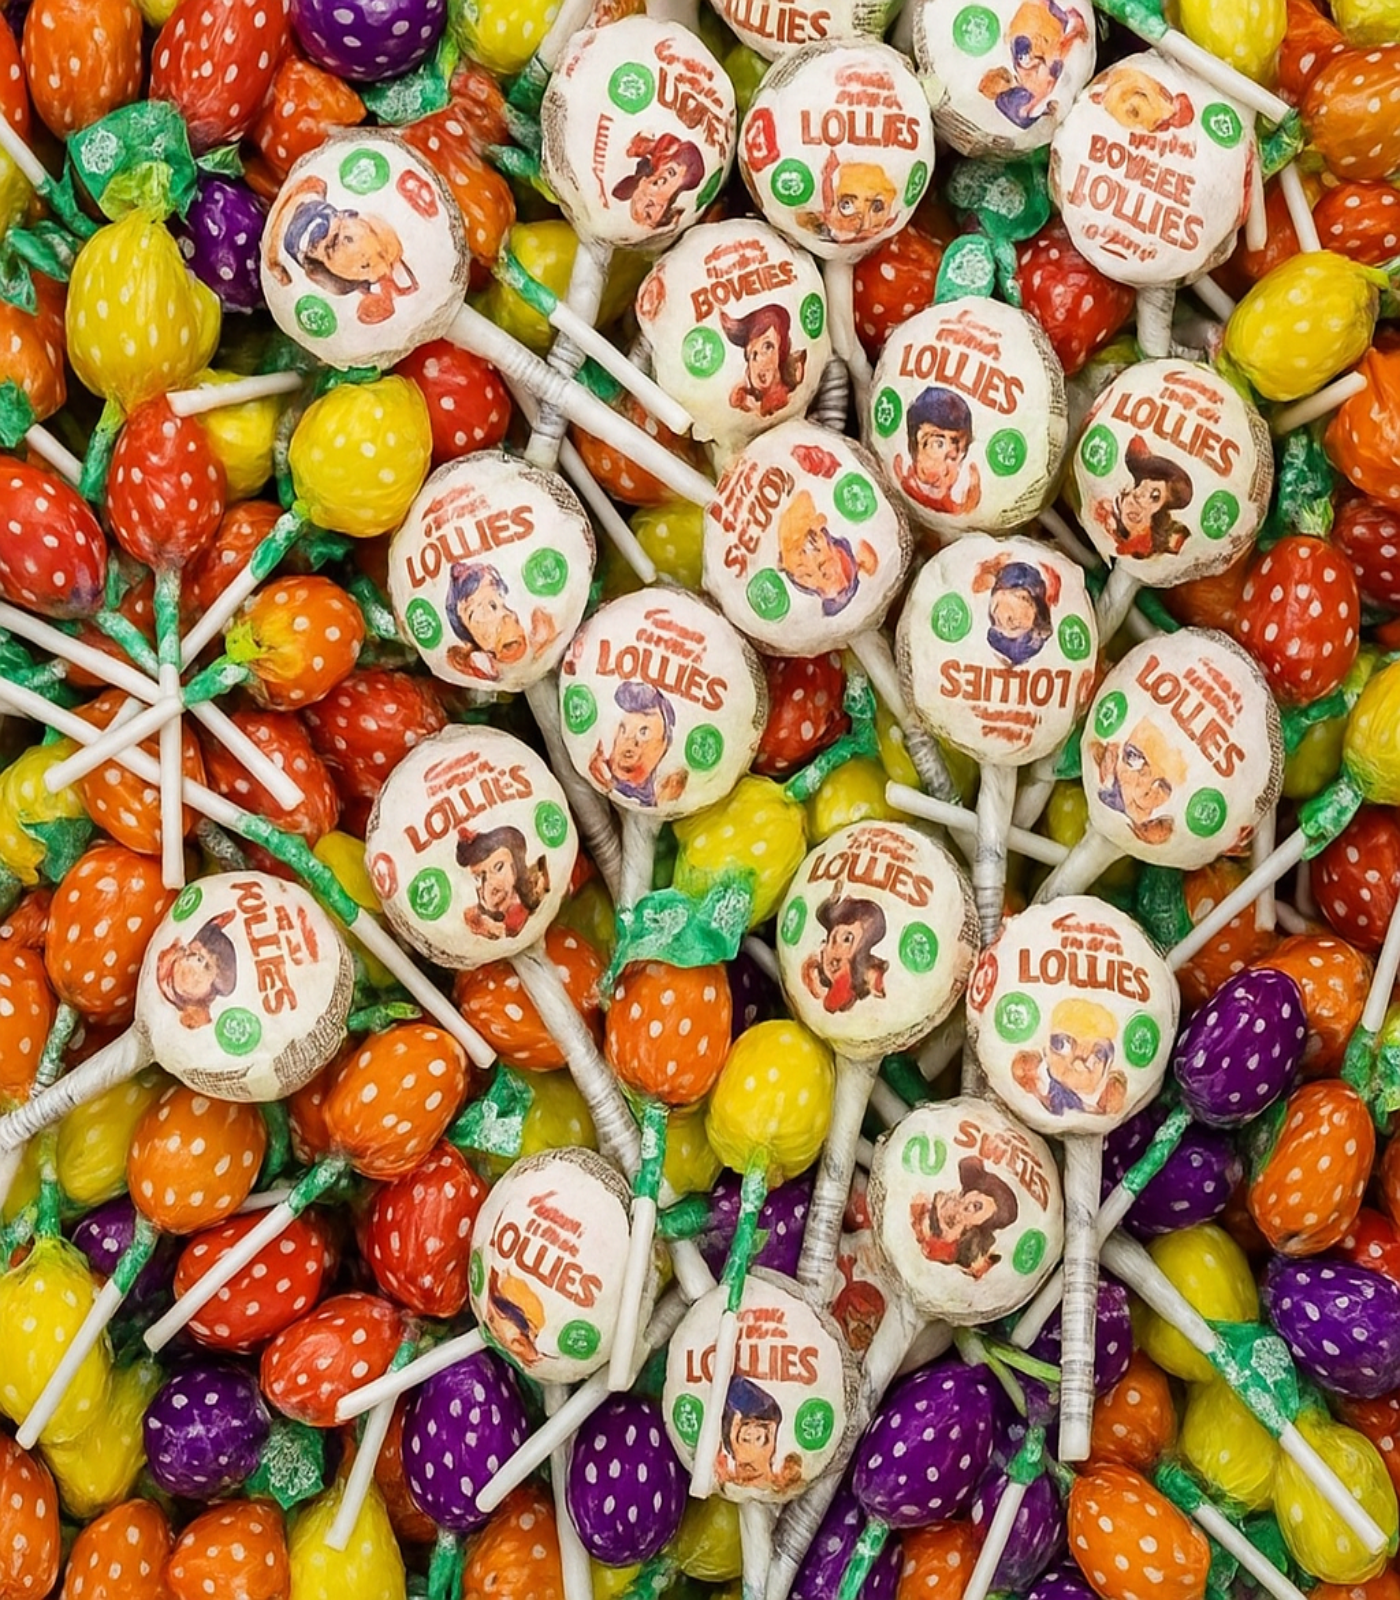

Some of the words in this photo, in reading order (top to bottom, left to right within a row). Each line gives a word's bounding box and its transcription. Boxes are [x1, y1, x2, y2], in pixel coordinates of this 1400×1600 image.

[801, 109, 921, 150] LOLLIES
[899, 344, 1025, 415] LOLLIES
[406, 505, 535, 589] LOLLIES
[596, 639, 728, 712] LOLLIES
[404, 765, 534, 854] LOLLIES
[807, 851, 934, 908] LOLLIES
[1018, 948, 1151, 1004] LOLLIES
